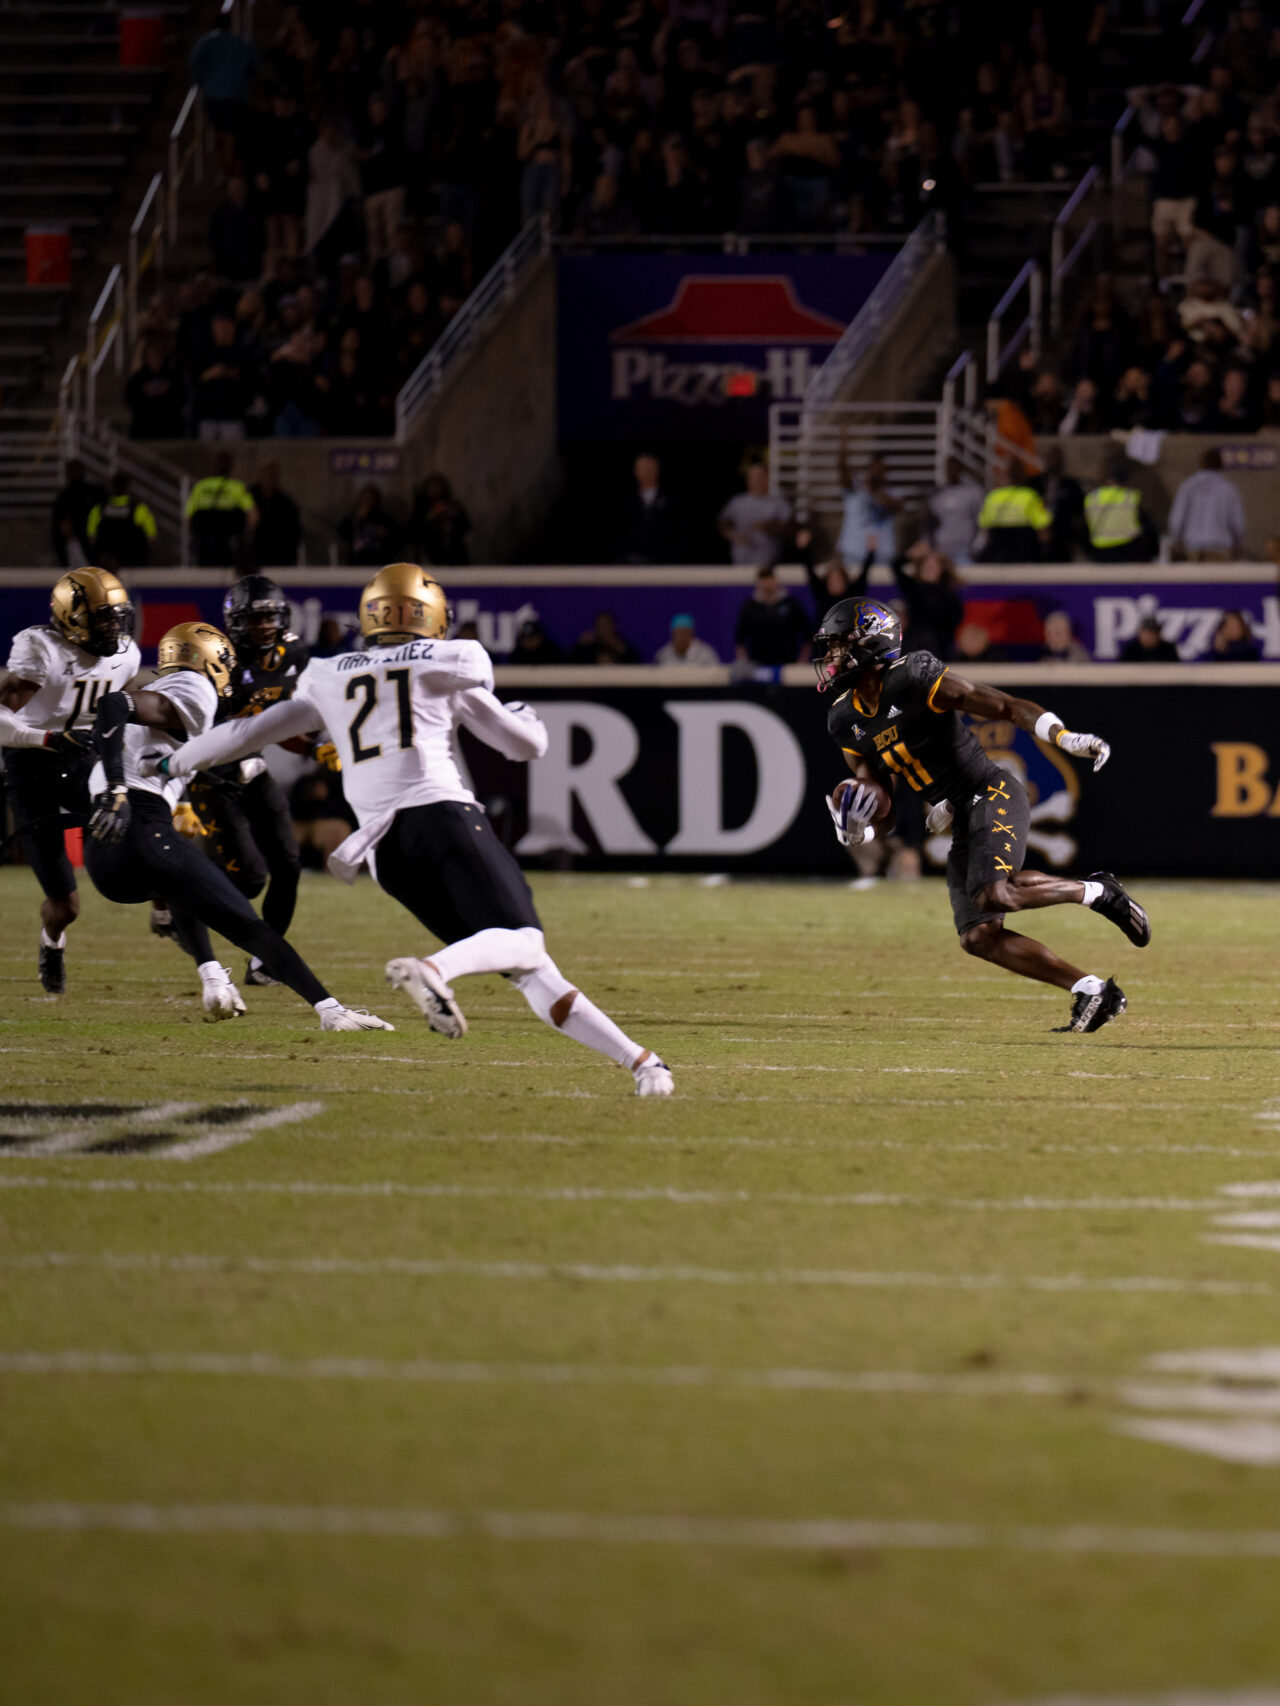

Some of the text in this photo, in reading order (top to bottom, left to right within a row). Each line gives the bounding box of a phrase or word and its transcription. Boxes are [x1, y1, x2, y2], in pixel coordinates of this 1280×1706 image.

[383, 606, 404, 625] 21
[345, 668, 415, 764] 21
[873, 724, 899, 752] ECU
[881, 741, 934, 793] 11
